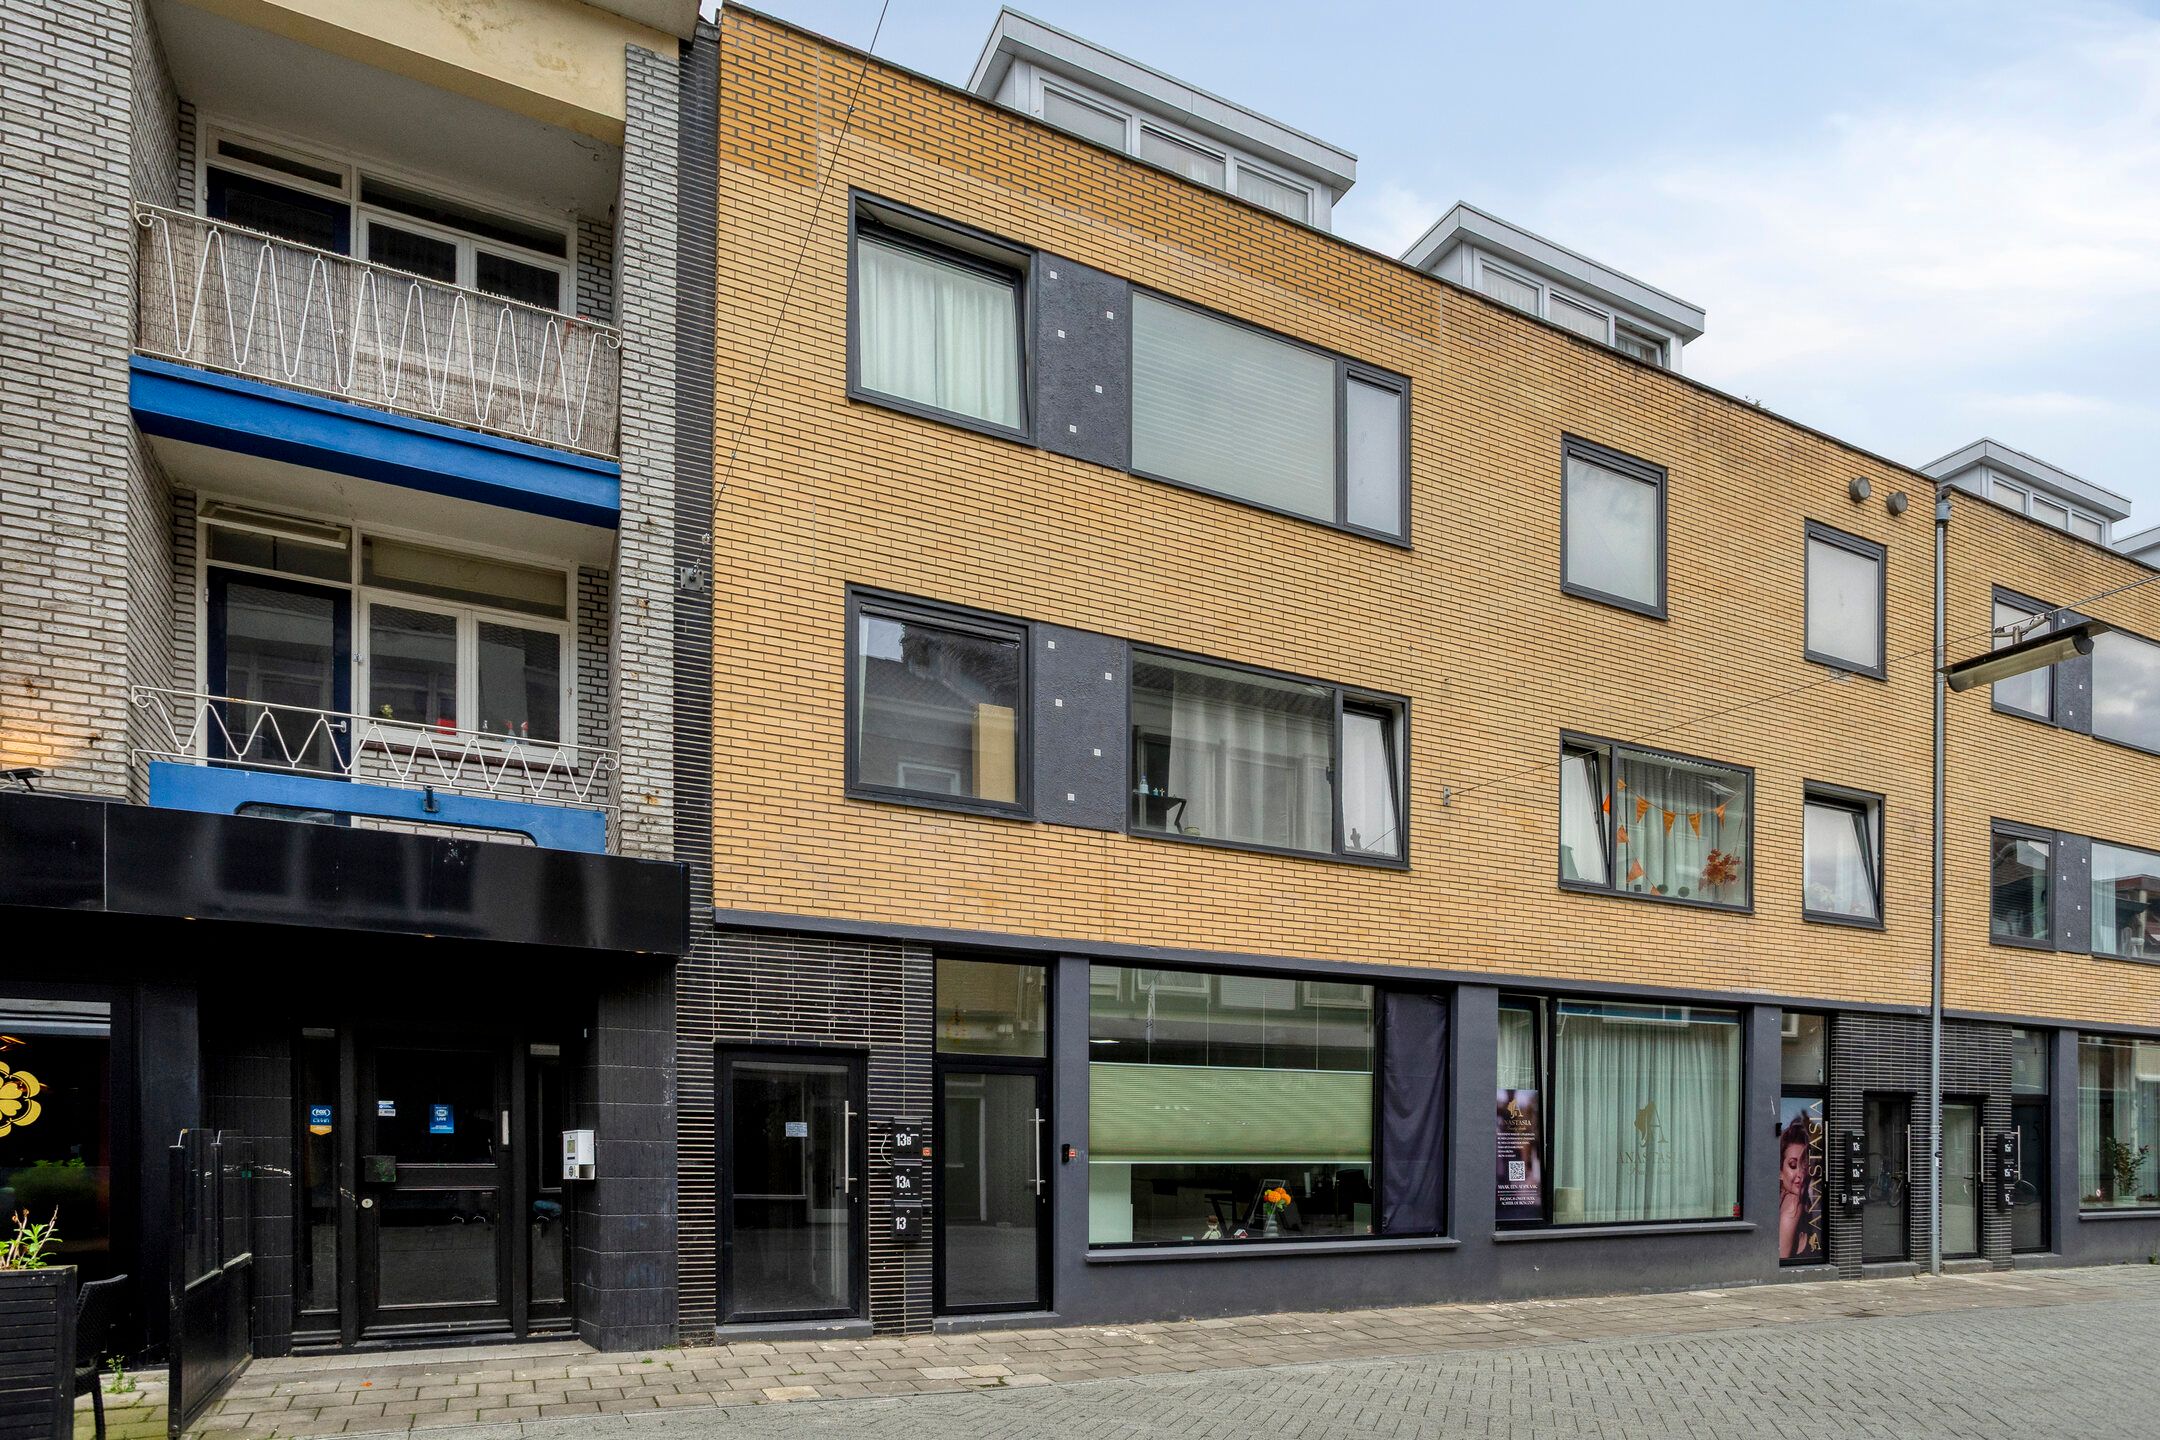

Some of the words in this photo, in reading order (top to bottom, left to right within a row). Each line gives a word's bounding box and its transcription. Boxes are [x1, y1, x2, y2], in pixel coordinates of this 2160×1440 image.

[896, 1133, 912, 1147] 13B
[1808, 1100, 1823, 1231] ANASTASIA
[895, 1175, 911, 1189] 13A
[895, 1216, 907, 1230] 13
